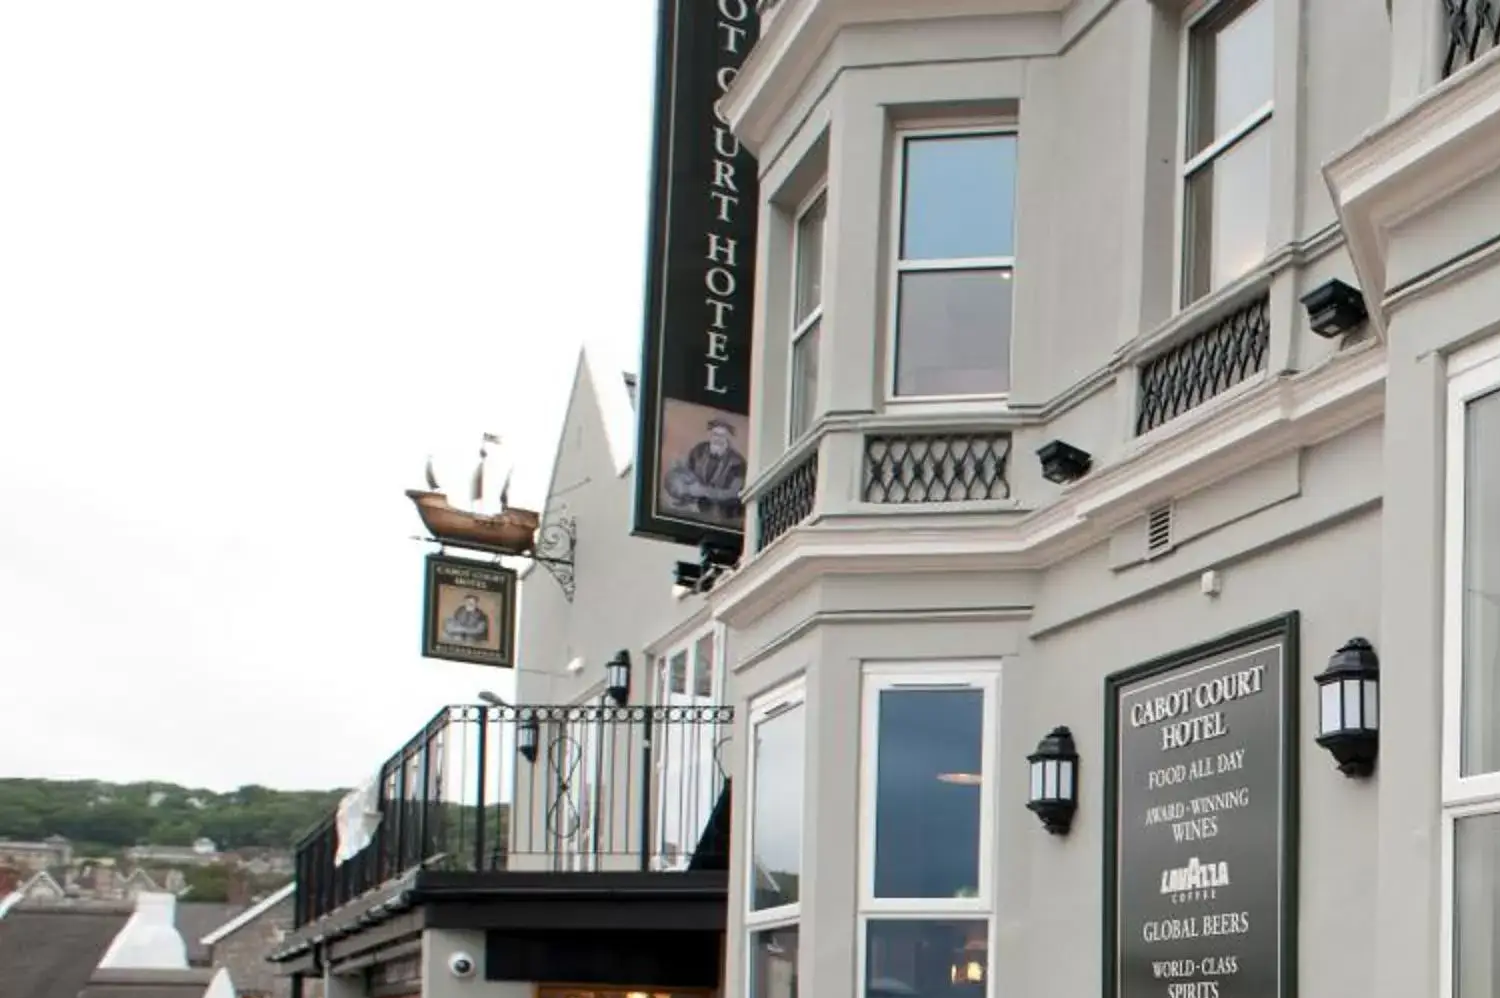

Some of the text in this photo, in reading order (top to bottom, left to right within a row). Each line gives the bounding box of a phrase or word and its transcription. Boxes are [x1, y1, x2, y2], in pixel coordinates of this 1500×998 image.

[704, 232, 738, 394] HOTEL
[1131, 665, 1265, 728] CABOT COURT
[1160, 711, 1228, 751] HOTEL
[1148, 749, 1245, 790] FOOD ALL DAY
[1172, 815, 1218, 843] WINES
[1171, 889, 1217, 904] COFFEE
[1143, 911, 1249, 942] GLOBAL BEERS
